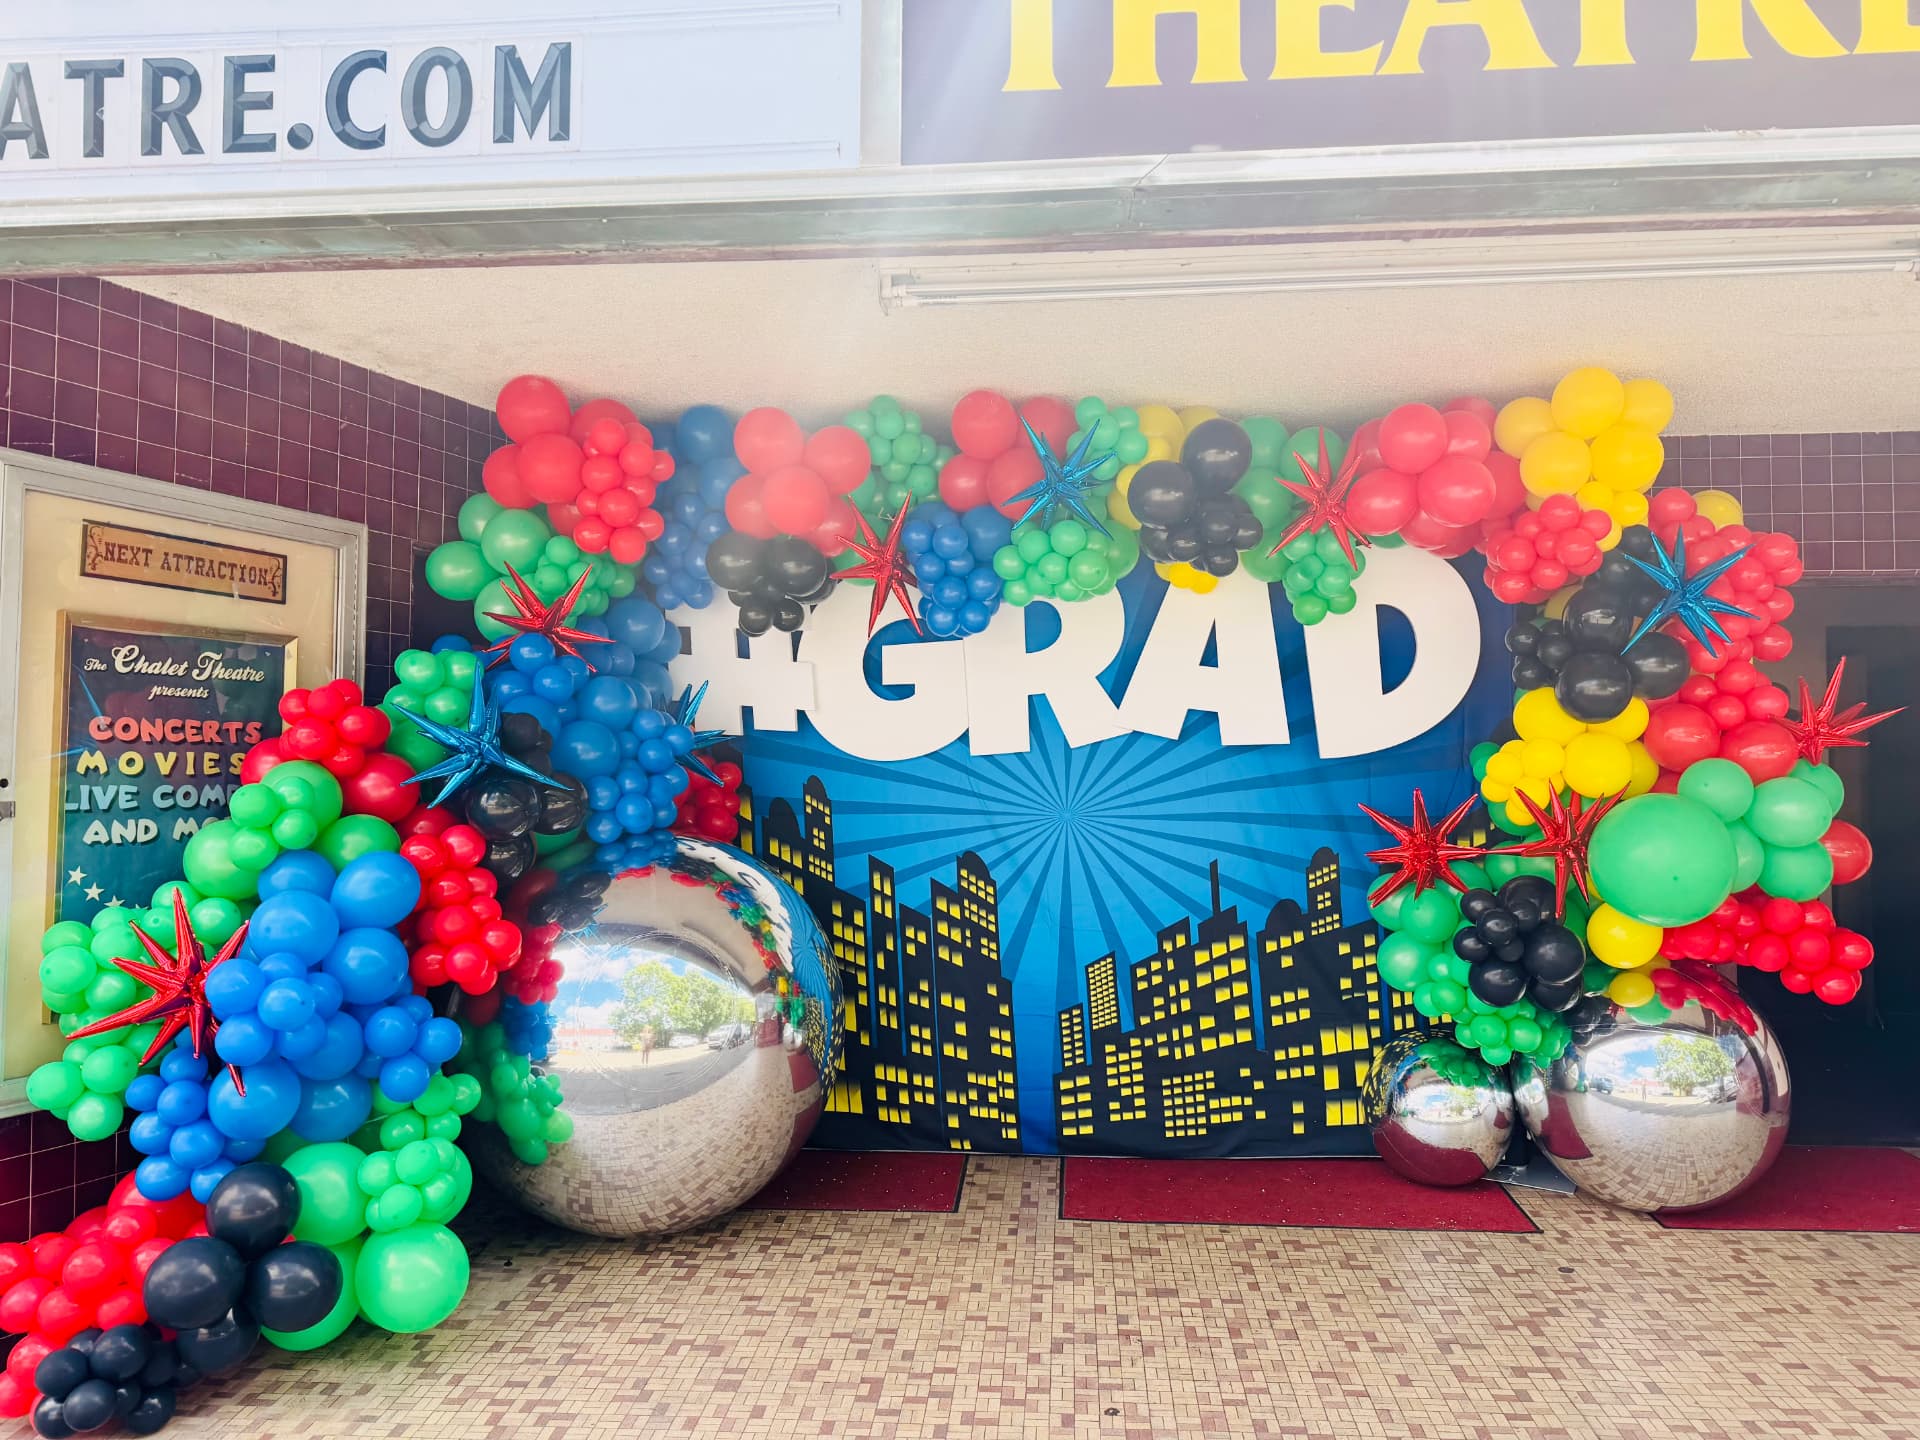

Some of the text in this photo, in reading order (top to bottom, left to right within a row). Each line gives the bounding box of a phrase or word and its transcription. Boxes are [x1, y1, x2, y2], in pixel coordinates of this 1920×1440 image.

[0, 41, 572, 161] ATRE.COM
[103, 541, 270, 586] NEXT ATTRACTION
[84, 644, 265, 682] The Chalet Theatre
[148, 684, 210, 700] presents
[88, 715, 263, 745] CONCERTS
[76, 750, 247, 776] MOVIES
[82, 818, 159, 845] AND
